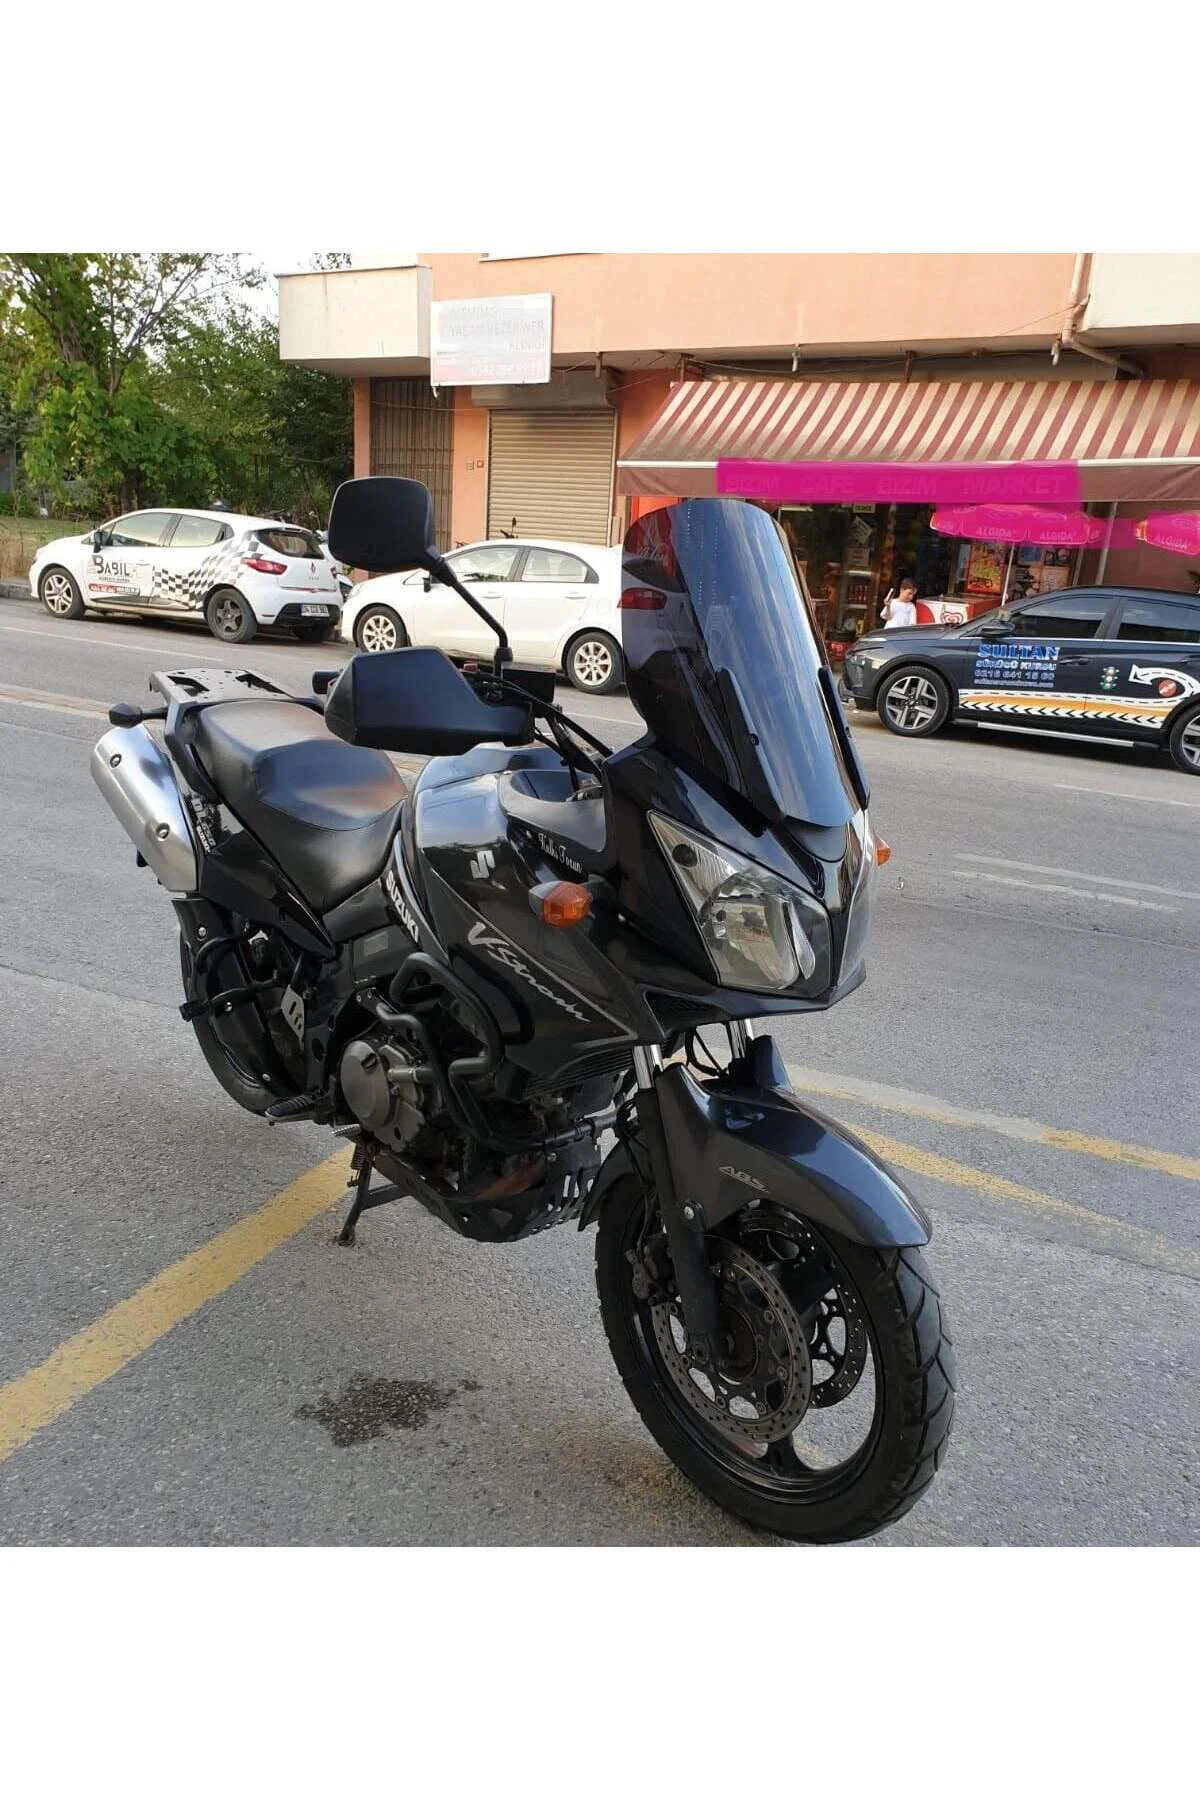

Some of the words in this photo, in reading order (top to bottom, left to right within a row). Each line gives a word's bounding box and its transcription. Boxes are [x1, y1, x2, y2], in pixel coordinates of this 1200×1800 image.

[961, 474, 1067, 496] MARKET
[977, 644, 1060, 661] SULTAN
[386, 870, 419, 943] SUZUKI
[719, 1166, 769, 1193] ABS
